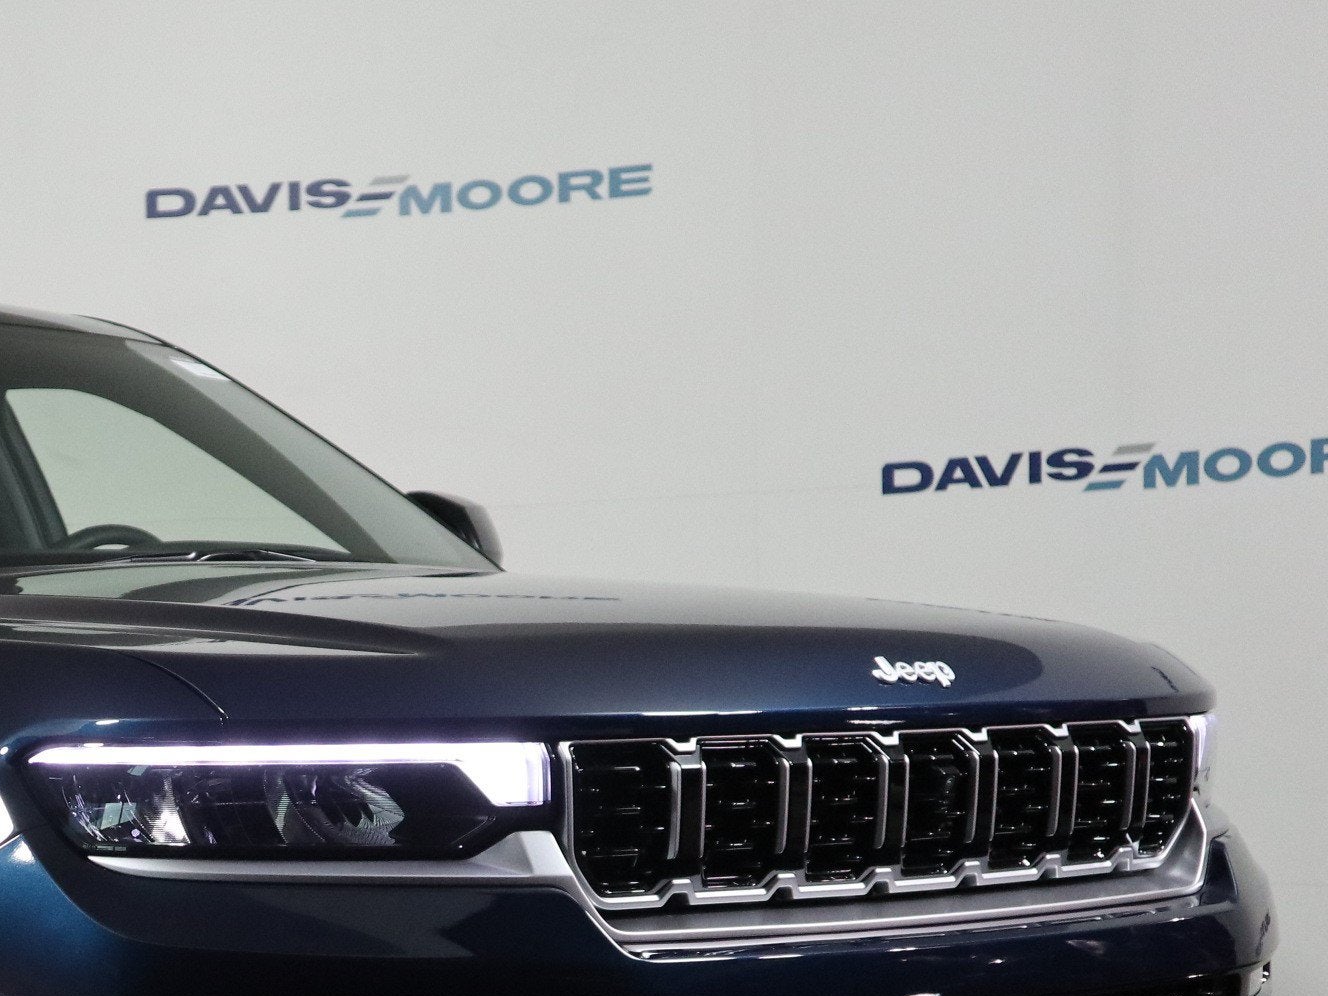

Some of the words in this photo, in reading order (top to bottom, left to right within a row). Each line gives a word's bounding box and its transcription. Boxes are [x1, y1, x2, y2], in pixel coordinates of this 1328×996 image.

[145, 178, 352, 219] DAVIS
[399, 163, 653, 216] MOORE
[881, 447, 1095, 496] DAVIS
[872, 655, 956, 688] Jeep
